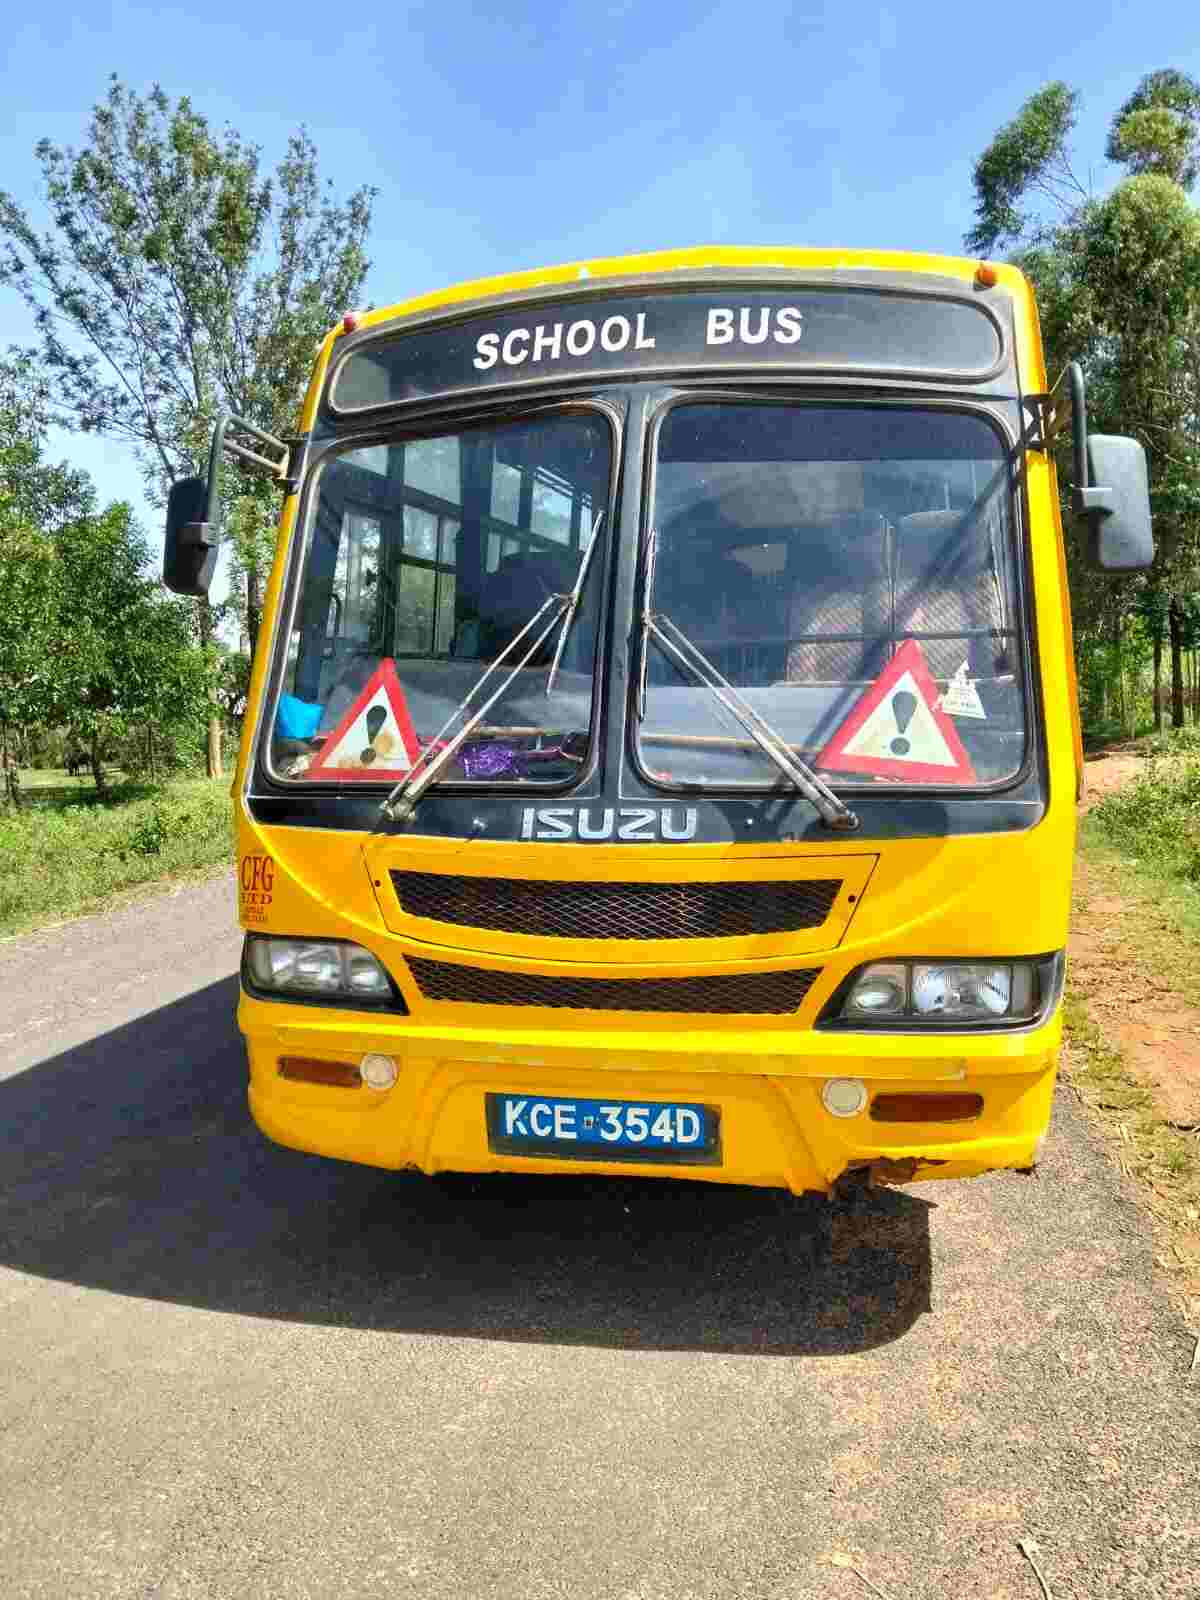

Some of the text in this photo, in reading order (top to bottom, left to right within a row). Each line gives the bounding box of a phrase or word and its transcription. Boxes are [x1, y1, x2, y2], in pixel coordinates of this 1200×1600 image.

[473, 307, 803, 370] SCHOOL BUS
[521, 807, 697, 839] ISUZU
[504, 1100, 700, 1143] KCE 354D
